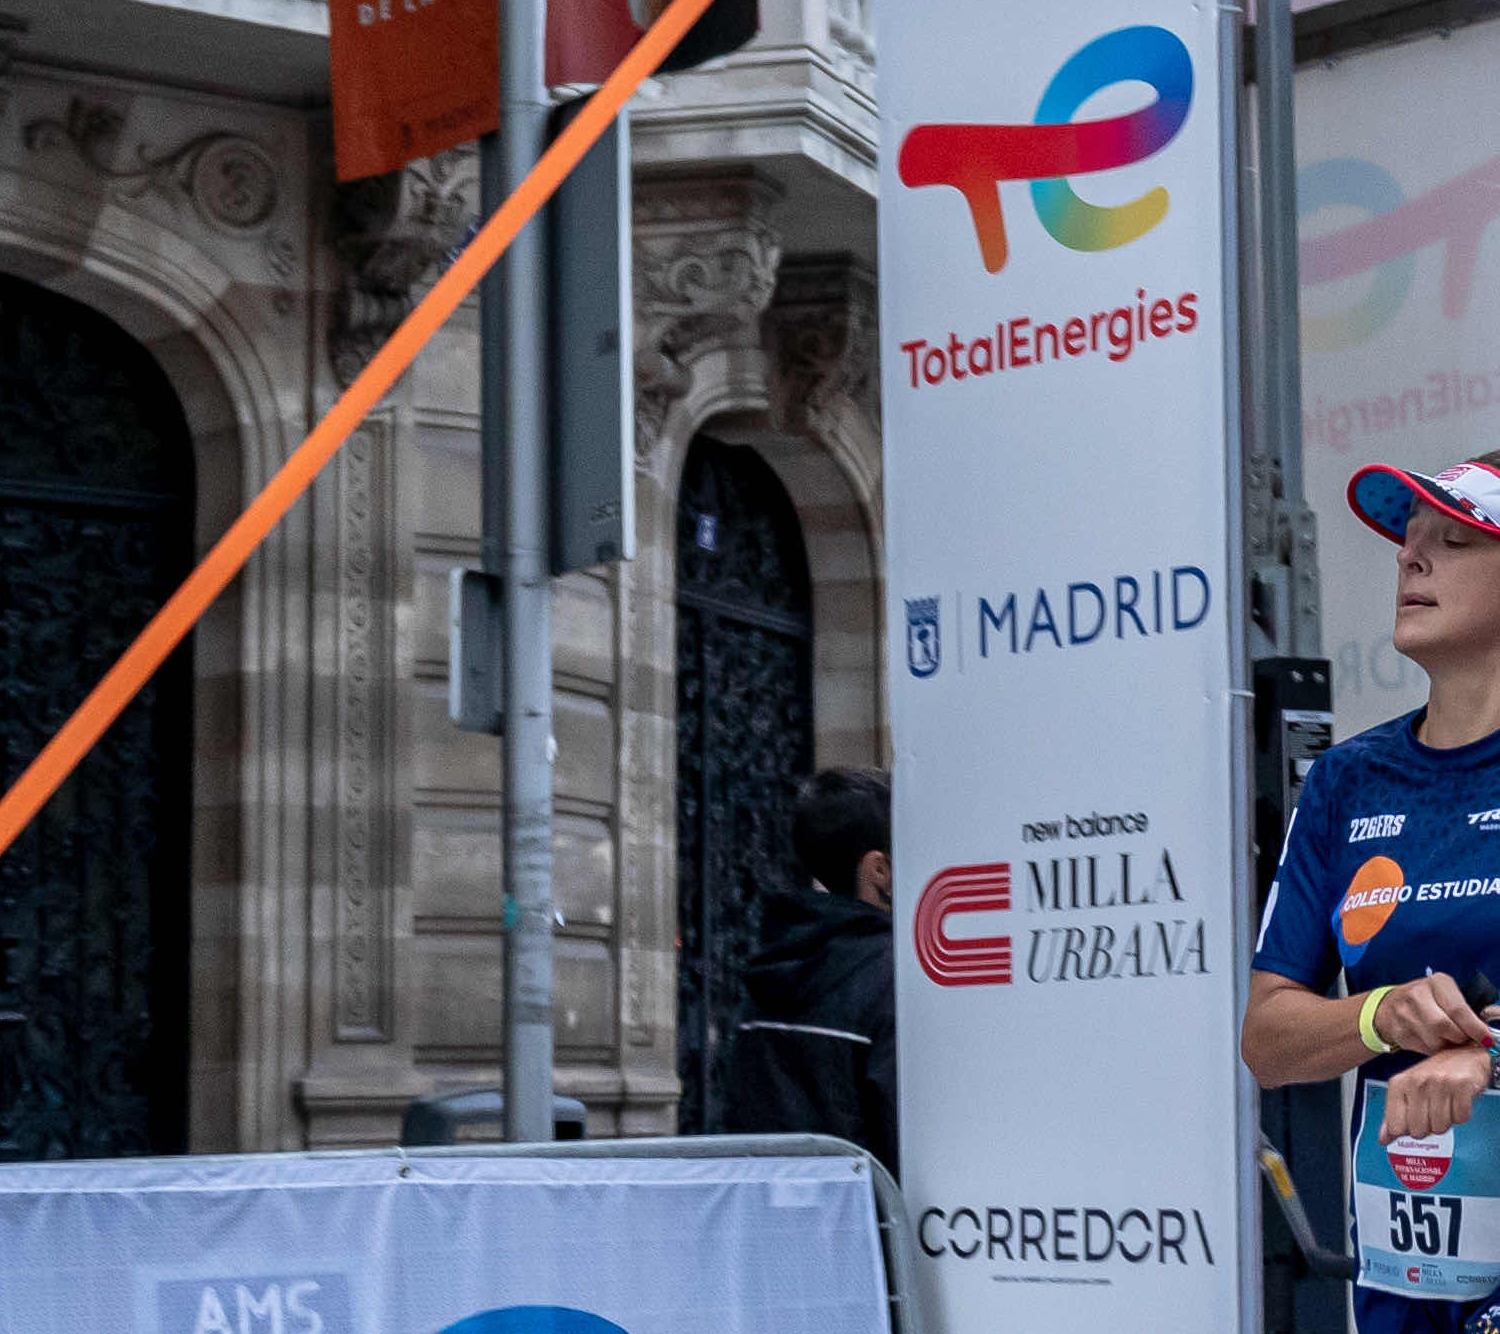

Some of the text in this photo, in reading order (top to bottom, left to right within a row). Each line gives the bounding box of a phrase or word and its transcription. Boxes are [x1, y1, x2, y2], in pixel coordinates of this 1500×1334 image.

[902, 287, 1198, 389] TotalEnergies
[978, 565, 1212, 659] MADRID
[1022, 811, 1149, 843] new balance
[1348, 814, 1406, 843] 226ERS
[1025, 847, 1185, 913] MILLA
[1343, 884, 1413, 912] COLEGIO
[1027, 918, 1211, 984] URBANA
[1388, 1191, 1463, 1258] 557
